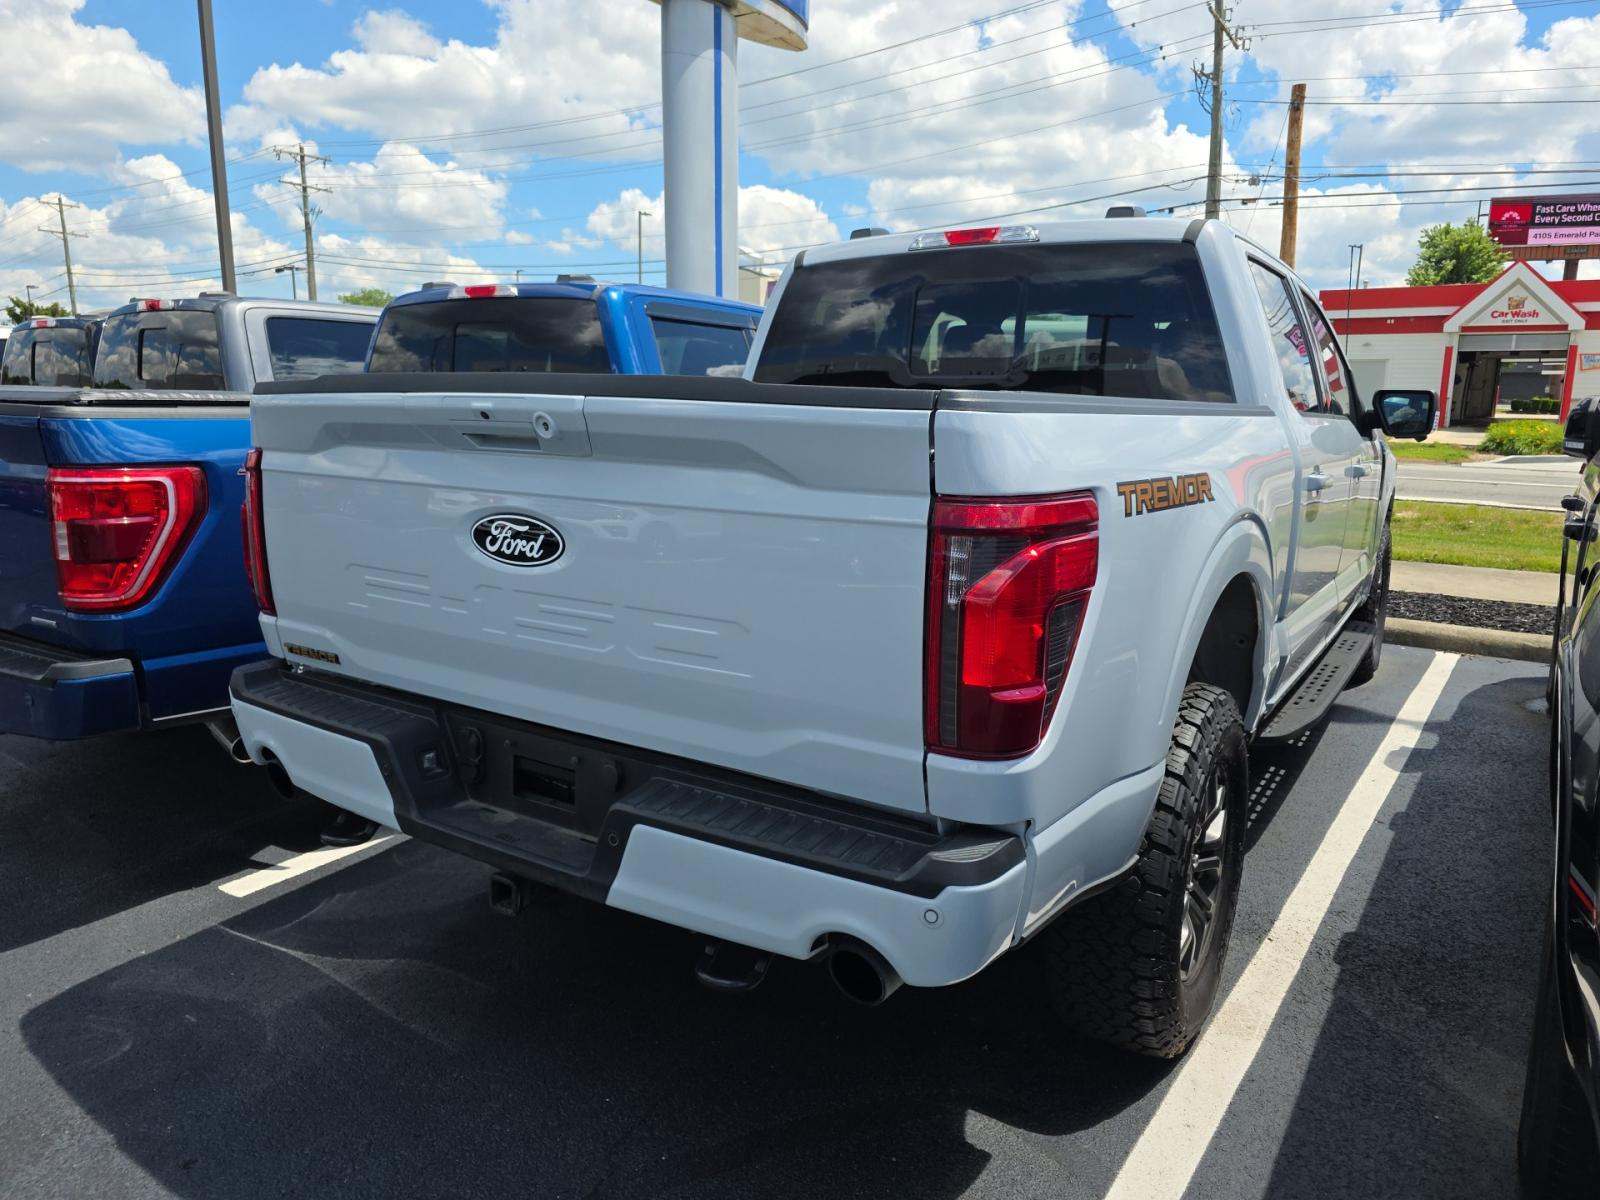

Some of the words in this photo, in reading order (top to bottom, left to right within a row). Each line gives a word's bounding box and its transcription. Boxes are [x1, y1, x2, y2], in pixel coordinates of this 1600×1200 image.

[1536, 205, 1555, 214] Fast
[1556, 204, 1576, 213] Care
[1535, 214, 1560, 224] Every
[1561, 213, 1593, 223] Second
[1553, 231, 1587, 239] Emerald
[1588, 230, 1600, 238] Pa
[1490, 310, 1509, 319] Car
[1510, 309, 1540, 319] Wash
[1116, 472, 1216, 517] TREMOR
[486, 520, 544, 558] Ford
